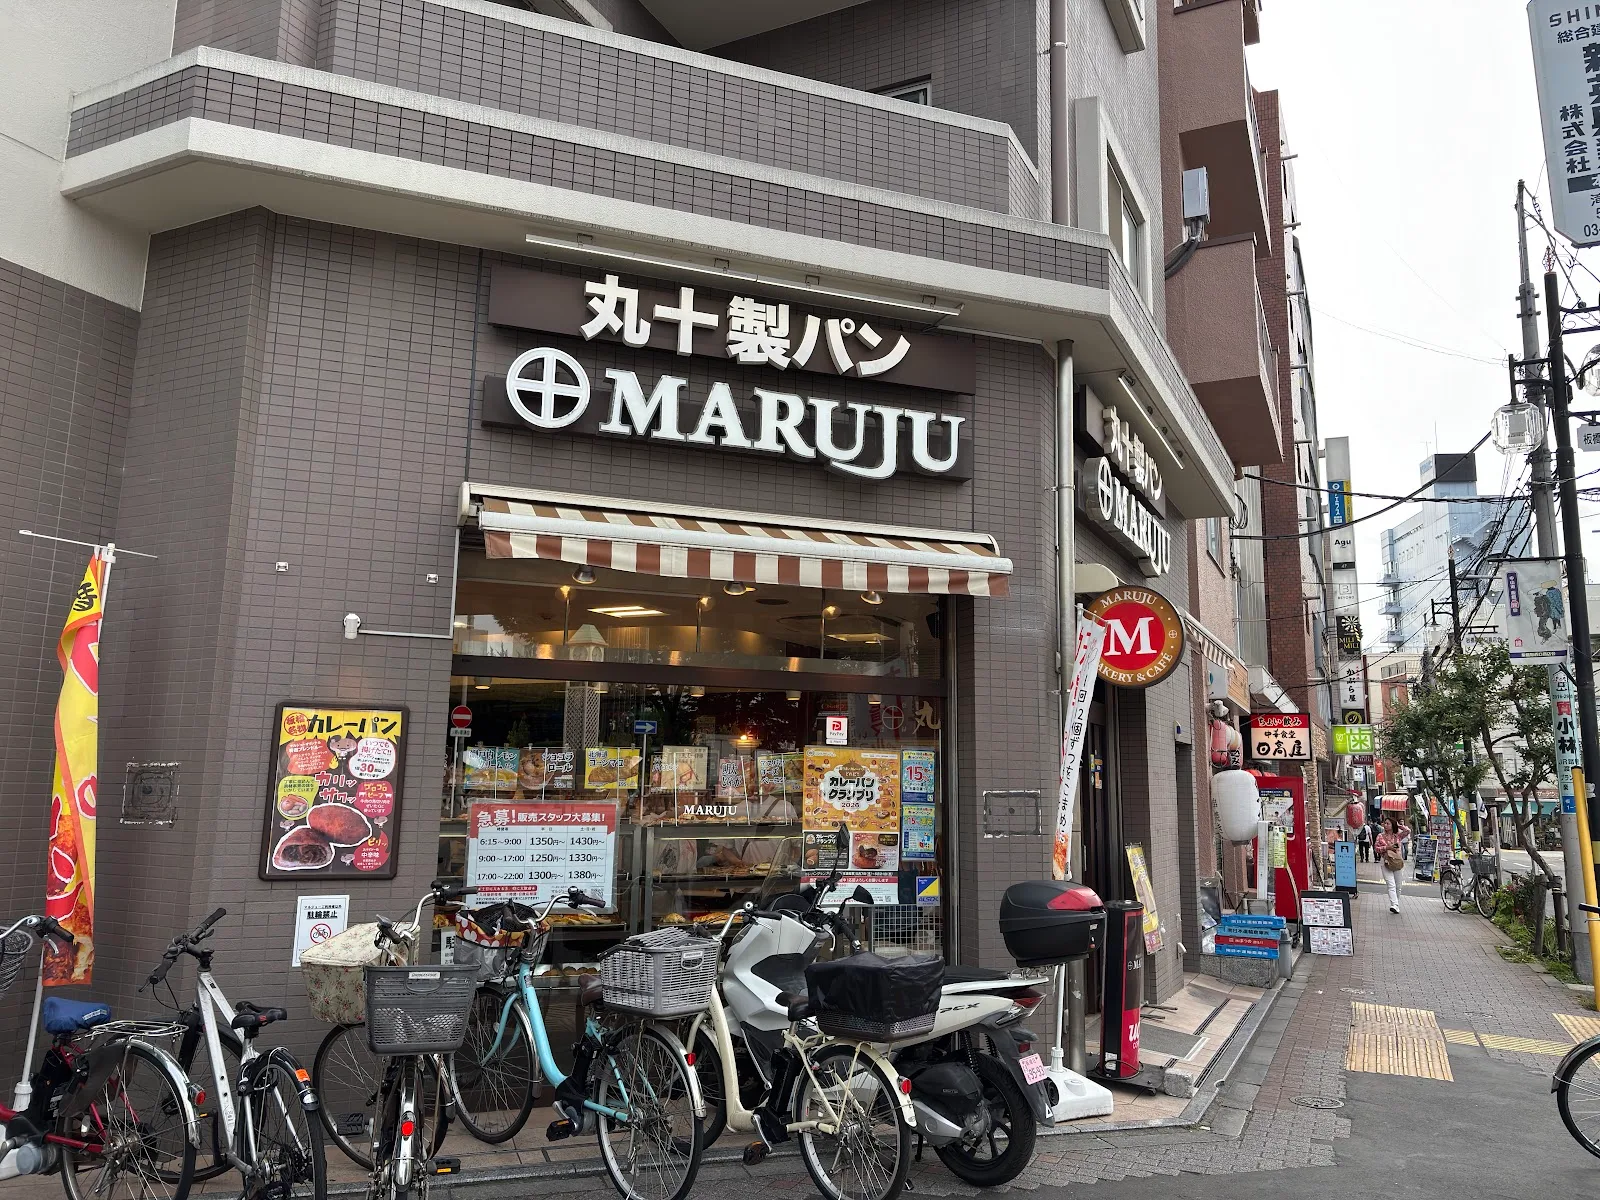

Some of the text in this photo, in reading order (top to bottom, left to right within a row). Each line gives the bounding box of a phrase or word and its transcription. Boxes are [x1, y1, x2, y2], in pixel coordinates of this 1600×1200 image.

[1559, 104, 1591, 174] 株式会社
[580, 274, 911, 378] 丸十製パン
[599, 367, 966, 480] MARUJU
[1113, 476, 1171, 577] MARUJU
[1101, 590, 1157, 607] MARUJU
[1104, 617, 1157, 656] M
[1098, 662, 1133, 684] AKERY
[308, 714, 397, 735] カレーパン
[1258, 716, 1302, 727] ちょい飲み
[1264, 728, 1297, 739] 中華食堂
[1346, 726, 1374, 753] 歯
[1556, 717, 1577, 754] 小林
[829, 776, 875, 788] カレーパン
[828, 788, 874, 801] グランプリ
[517, 812, 605, 822] 販売スタッフ大募集!
[683, 804, 737, 818] MARUJU
[307, 911, 338, 919] 駐輪禁止
